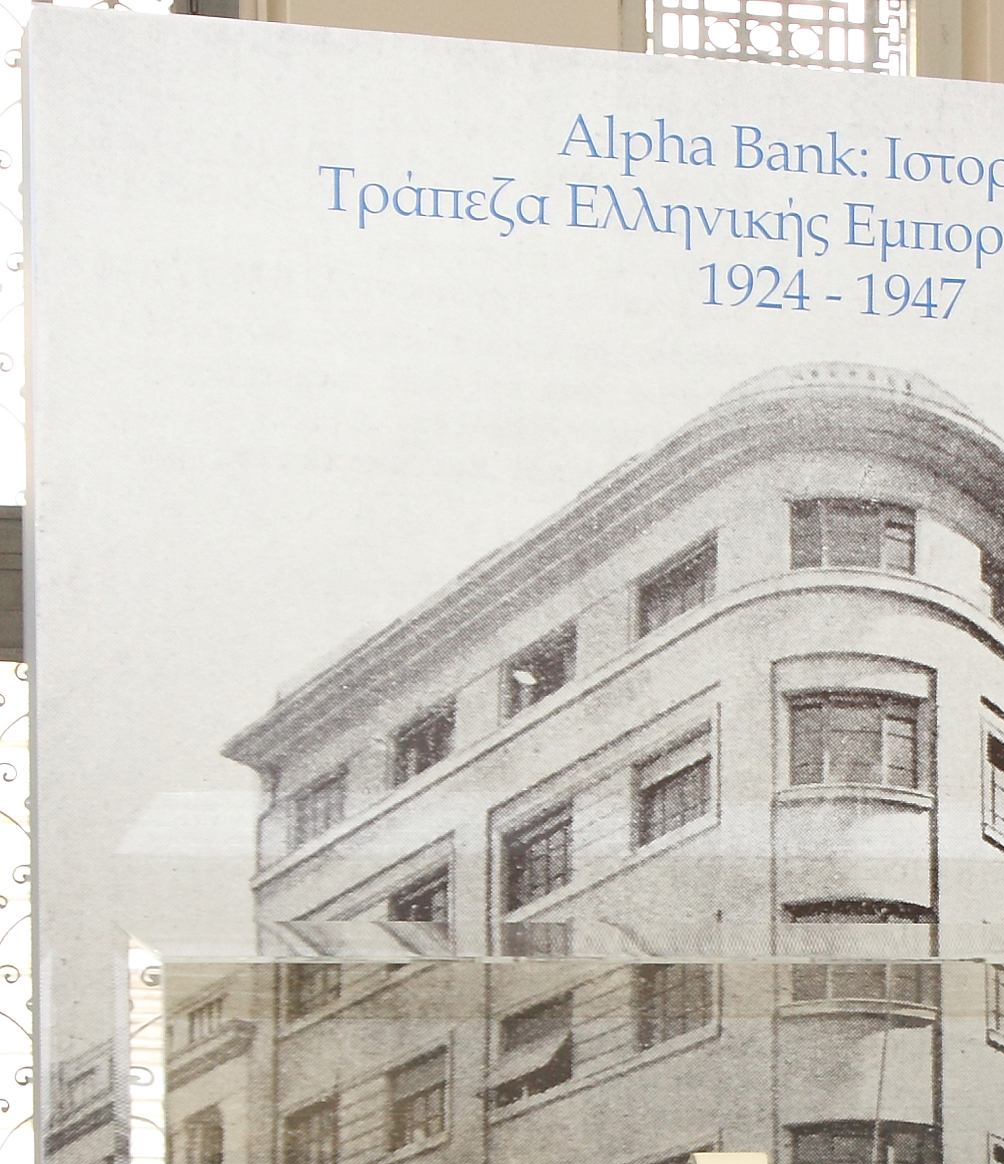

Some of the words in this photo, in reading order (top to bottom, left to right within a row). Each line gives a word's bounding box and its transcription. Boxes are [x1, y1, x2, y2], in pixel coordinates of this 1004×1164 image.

[559, 113, 714, 178] Alpha
[734, 124, 869, 178] Bank:
[319, 164, 550, 238] Τράπεζα
[566, 183, 831, 258] Ελληνικής
[699, 262, 811, 313] 1924
[858, 273, 967, 320] 1947
